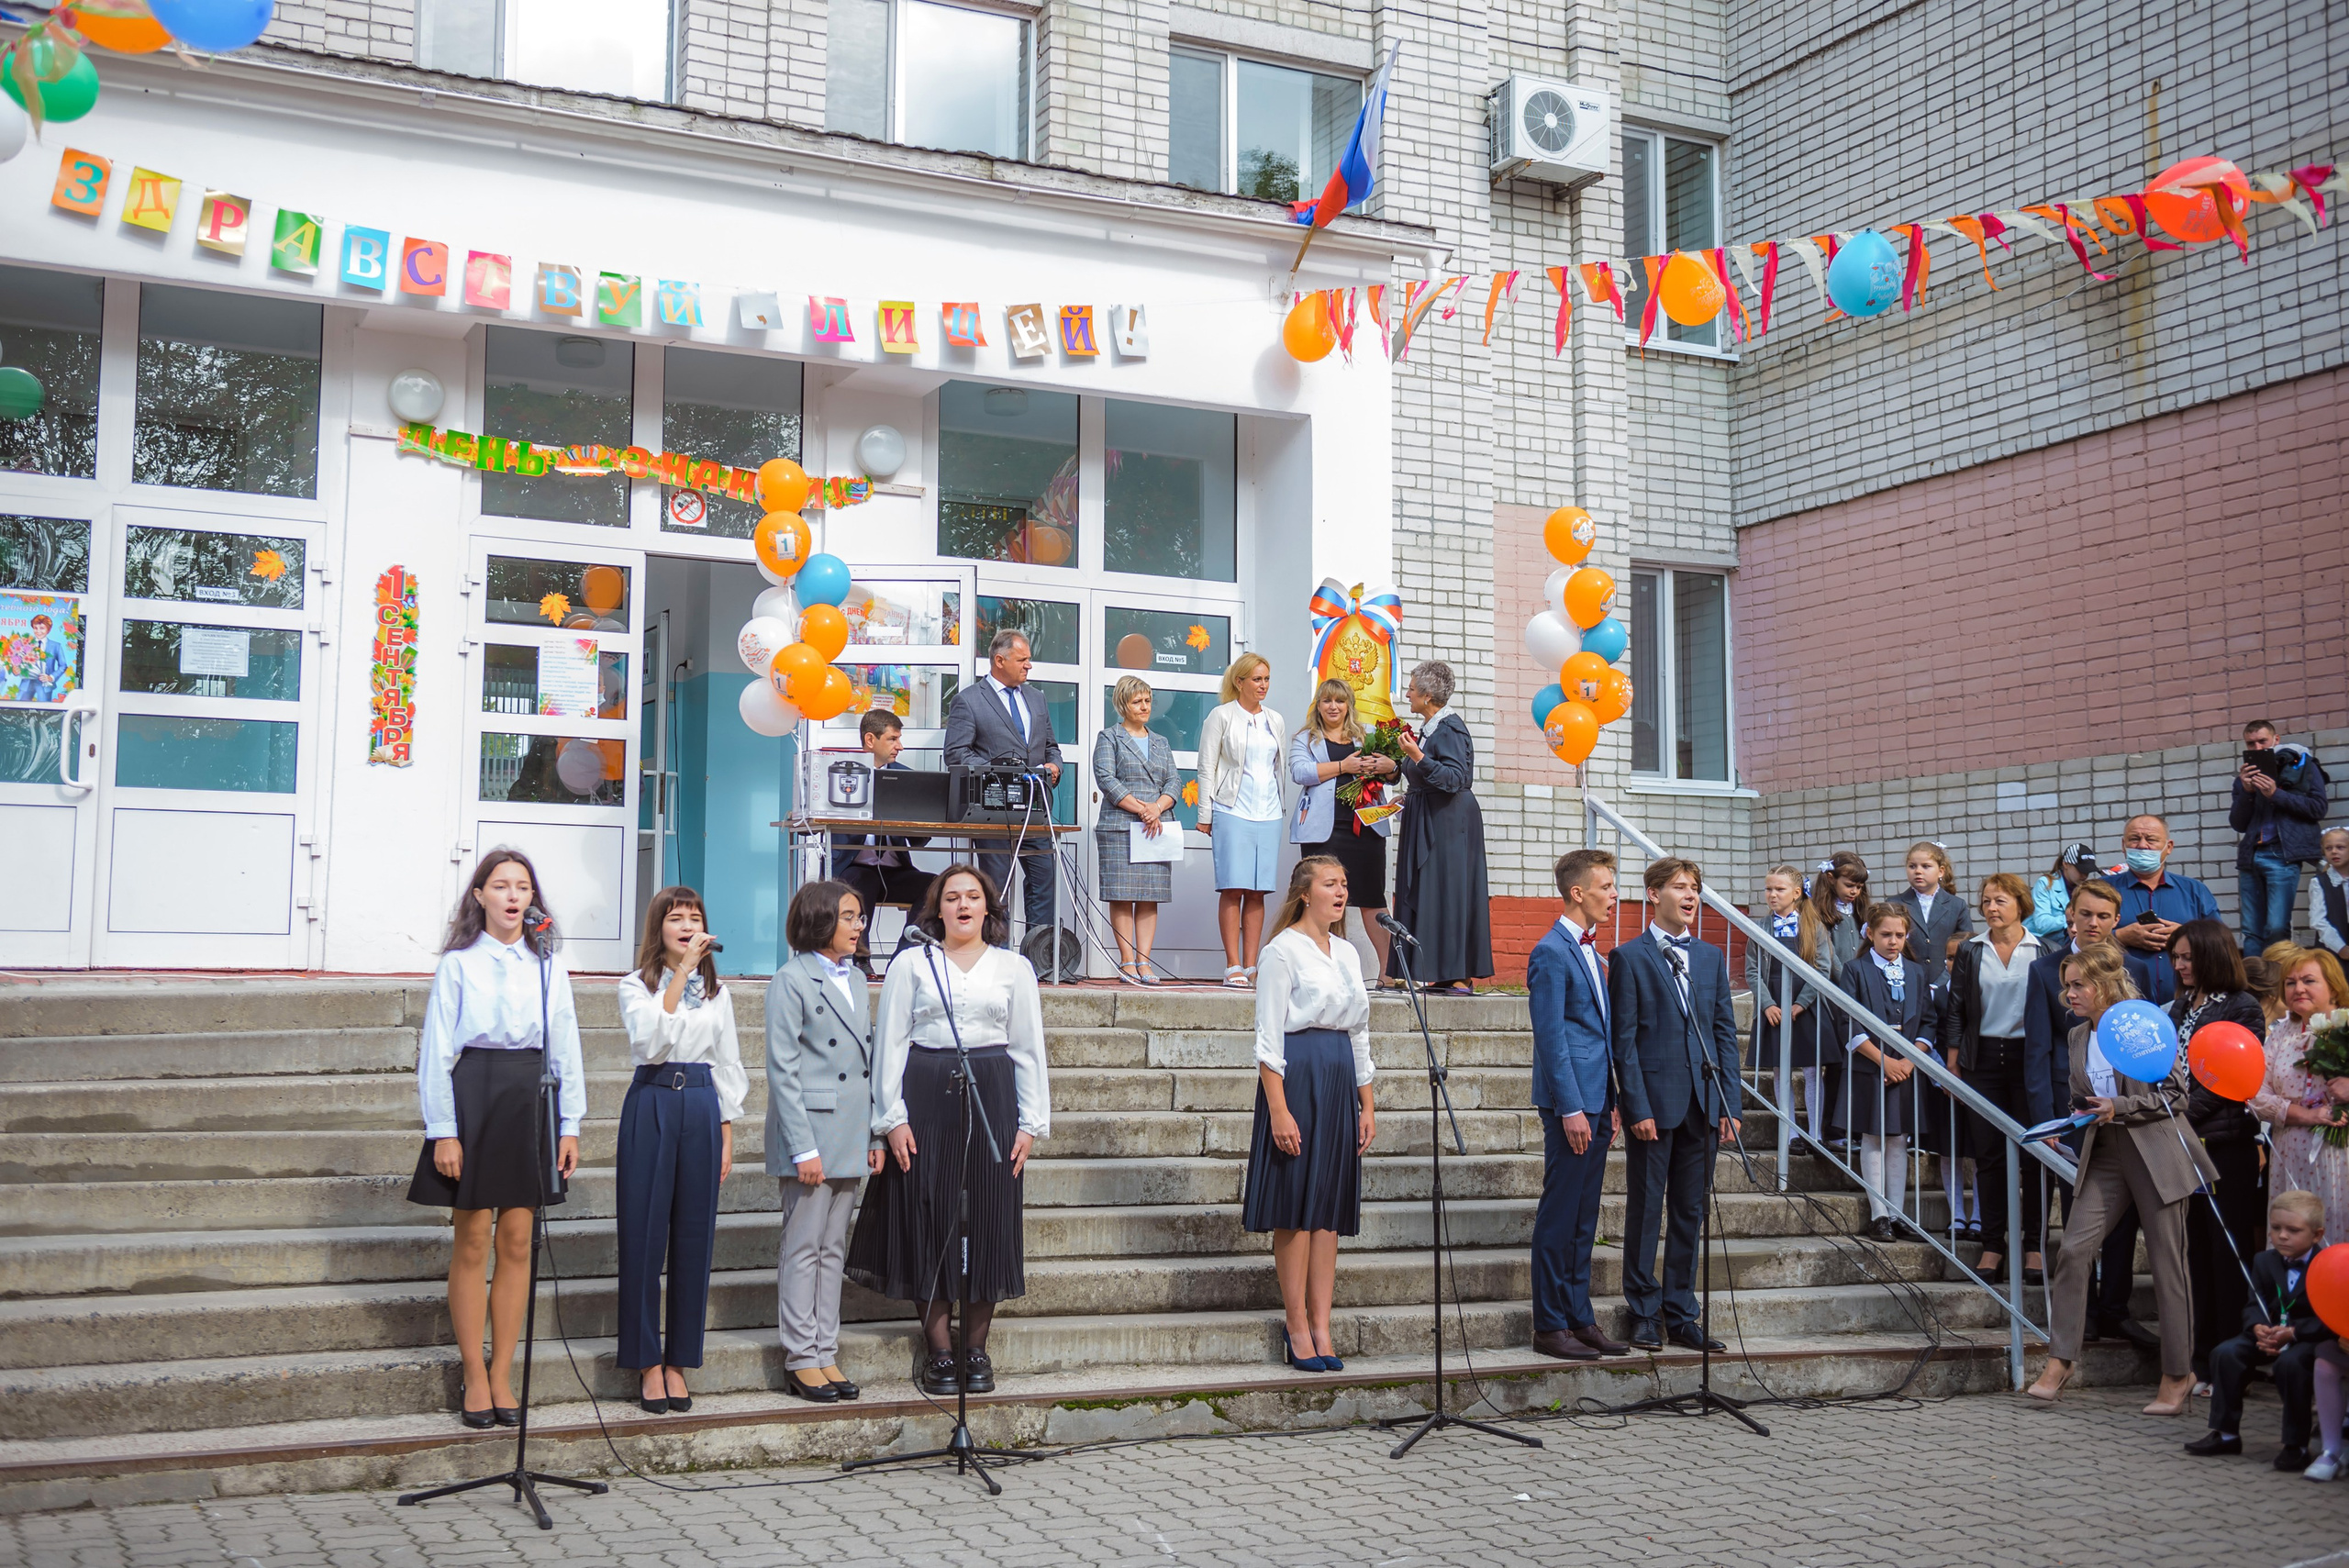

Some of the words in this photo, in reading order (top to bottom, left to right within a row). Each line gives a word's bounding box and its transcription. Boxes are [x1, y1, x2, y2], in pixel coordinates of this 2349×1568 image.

[816, 302, 1138, 351] ЛИЦЕЙ!
[398, 421, 548, 477] ДЕНЬ
[624, 446, 842, 510] ЗНАНЙ!
[781, 538, 788, 551] 1
[387, 564, 406, 599] 1
[199, 589, 220, 598] ВХОД
[42, 599, 73, 617] года!
[1158, 655, 1174, 663] ВХОД
[377, 605, 411, 762] СЕНТЯБРЯ
[2153, 1030, 2162, 1044] 1
